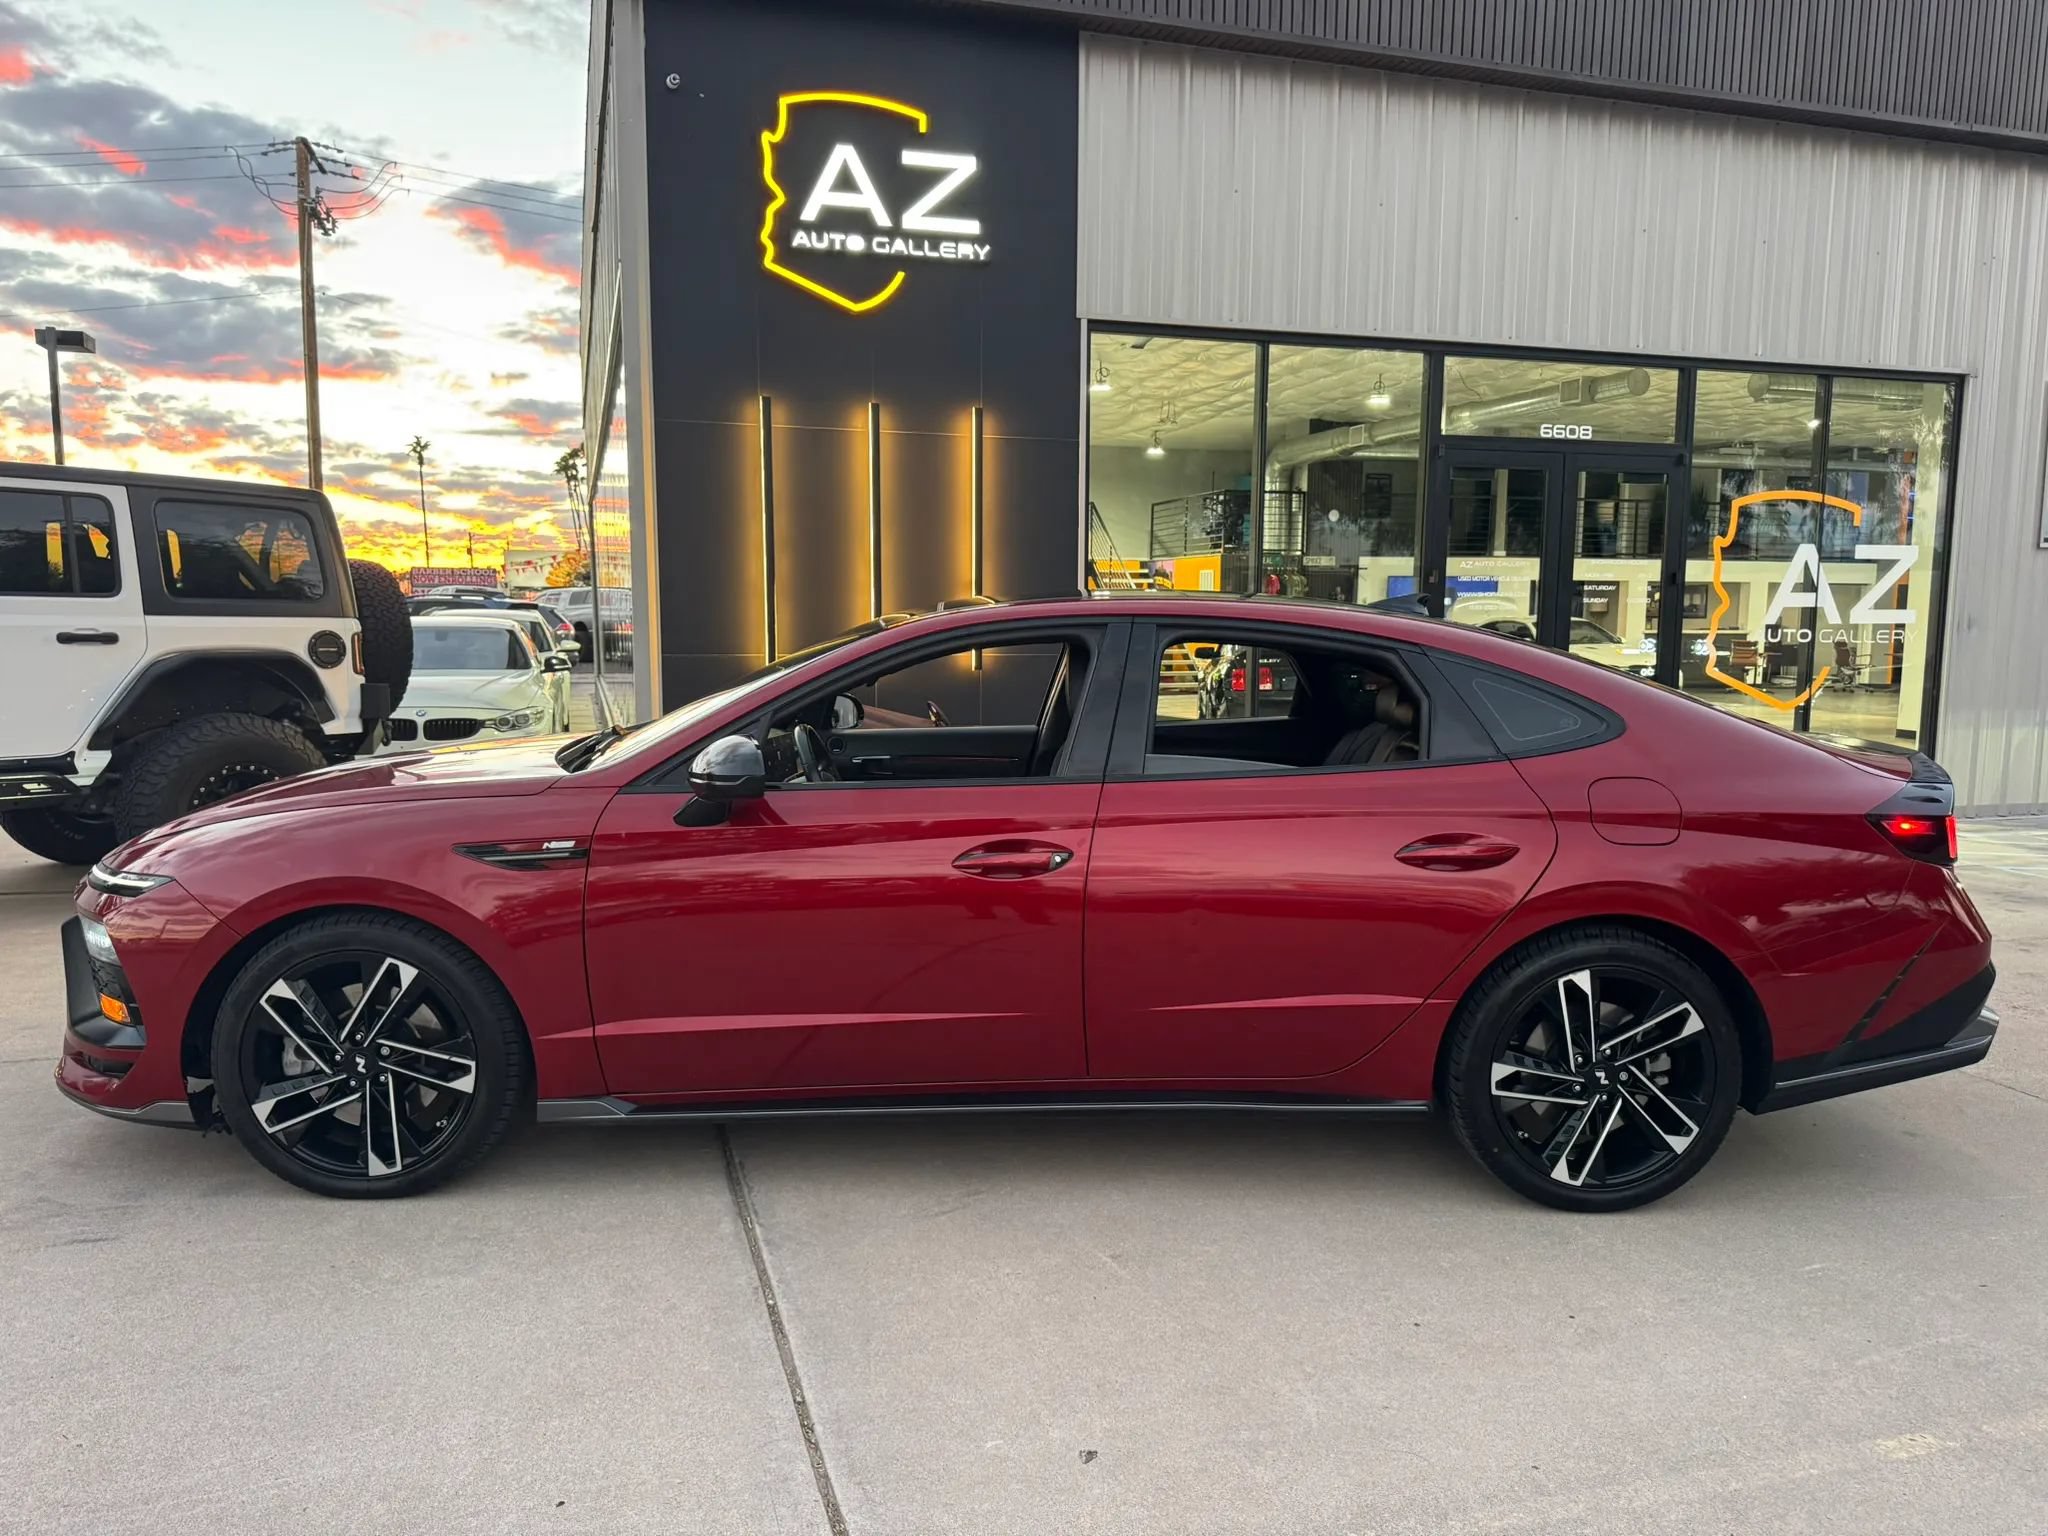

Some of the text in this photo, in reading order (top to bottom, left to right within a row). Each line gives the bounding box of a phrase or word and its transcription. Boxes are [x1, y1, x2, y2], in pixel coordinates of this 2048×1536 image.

[799, 143, 981, 235] AZ
[791, 230, 990, 260] AUTO GALLERY
[1539, 424, 1593, 440] 6608
[413, 576, 436, 584] NOW
[1583, 584, 1617, 592] SATURDAY
[1763, 543, 1919, 625] AZ
[1582, 596, 1609, 604] SUNDAY
[1756, 628, 1919, 645] UTO GALLERY
